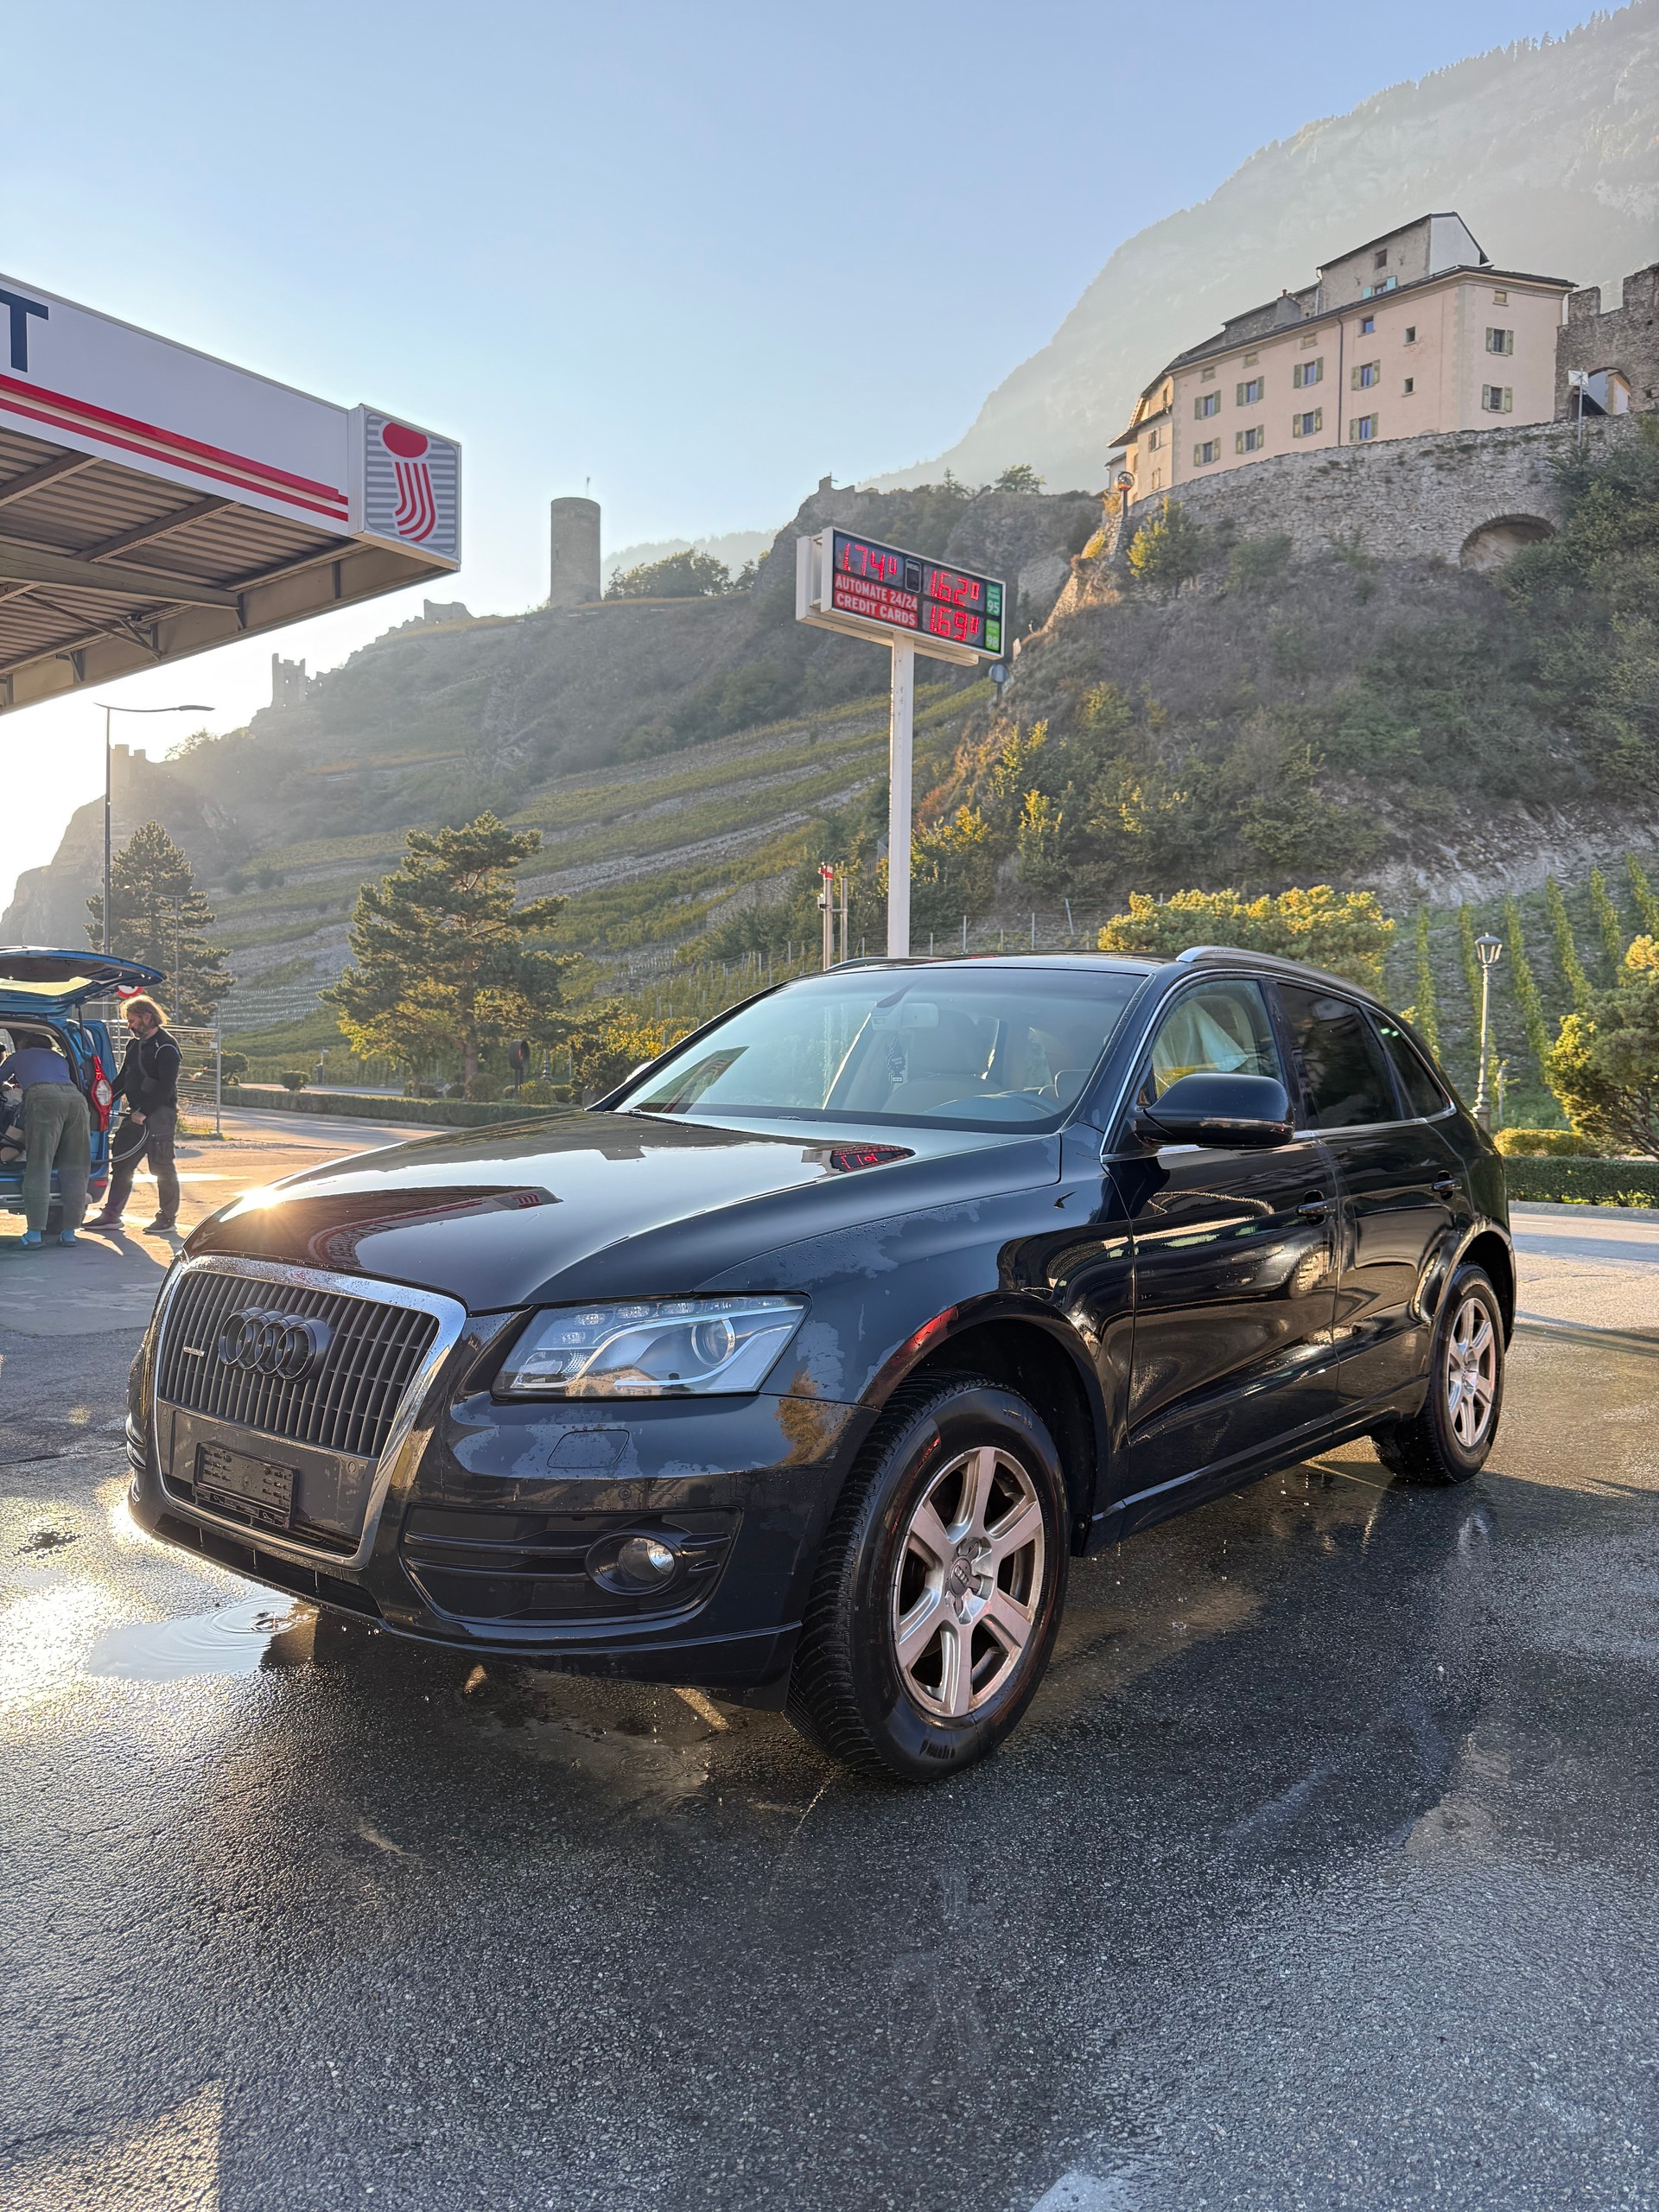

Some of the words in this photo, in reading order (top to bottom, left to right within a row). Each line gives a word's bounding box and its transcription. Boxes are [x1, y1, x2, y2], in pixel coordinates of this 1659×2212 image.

[836, 575, 887, 601] AUTOMATE
[890, 591, 918, 610] 24/24
[836, 593, 877, 614] CREDIT
[880, 605, 916, 626] CARDS
[987, 600, 1000, 614] 95
[986, 634, 999, 648] 98
